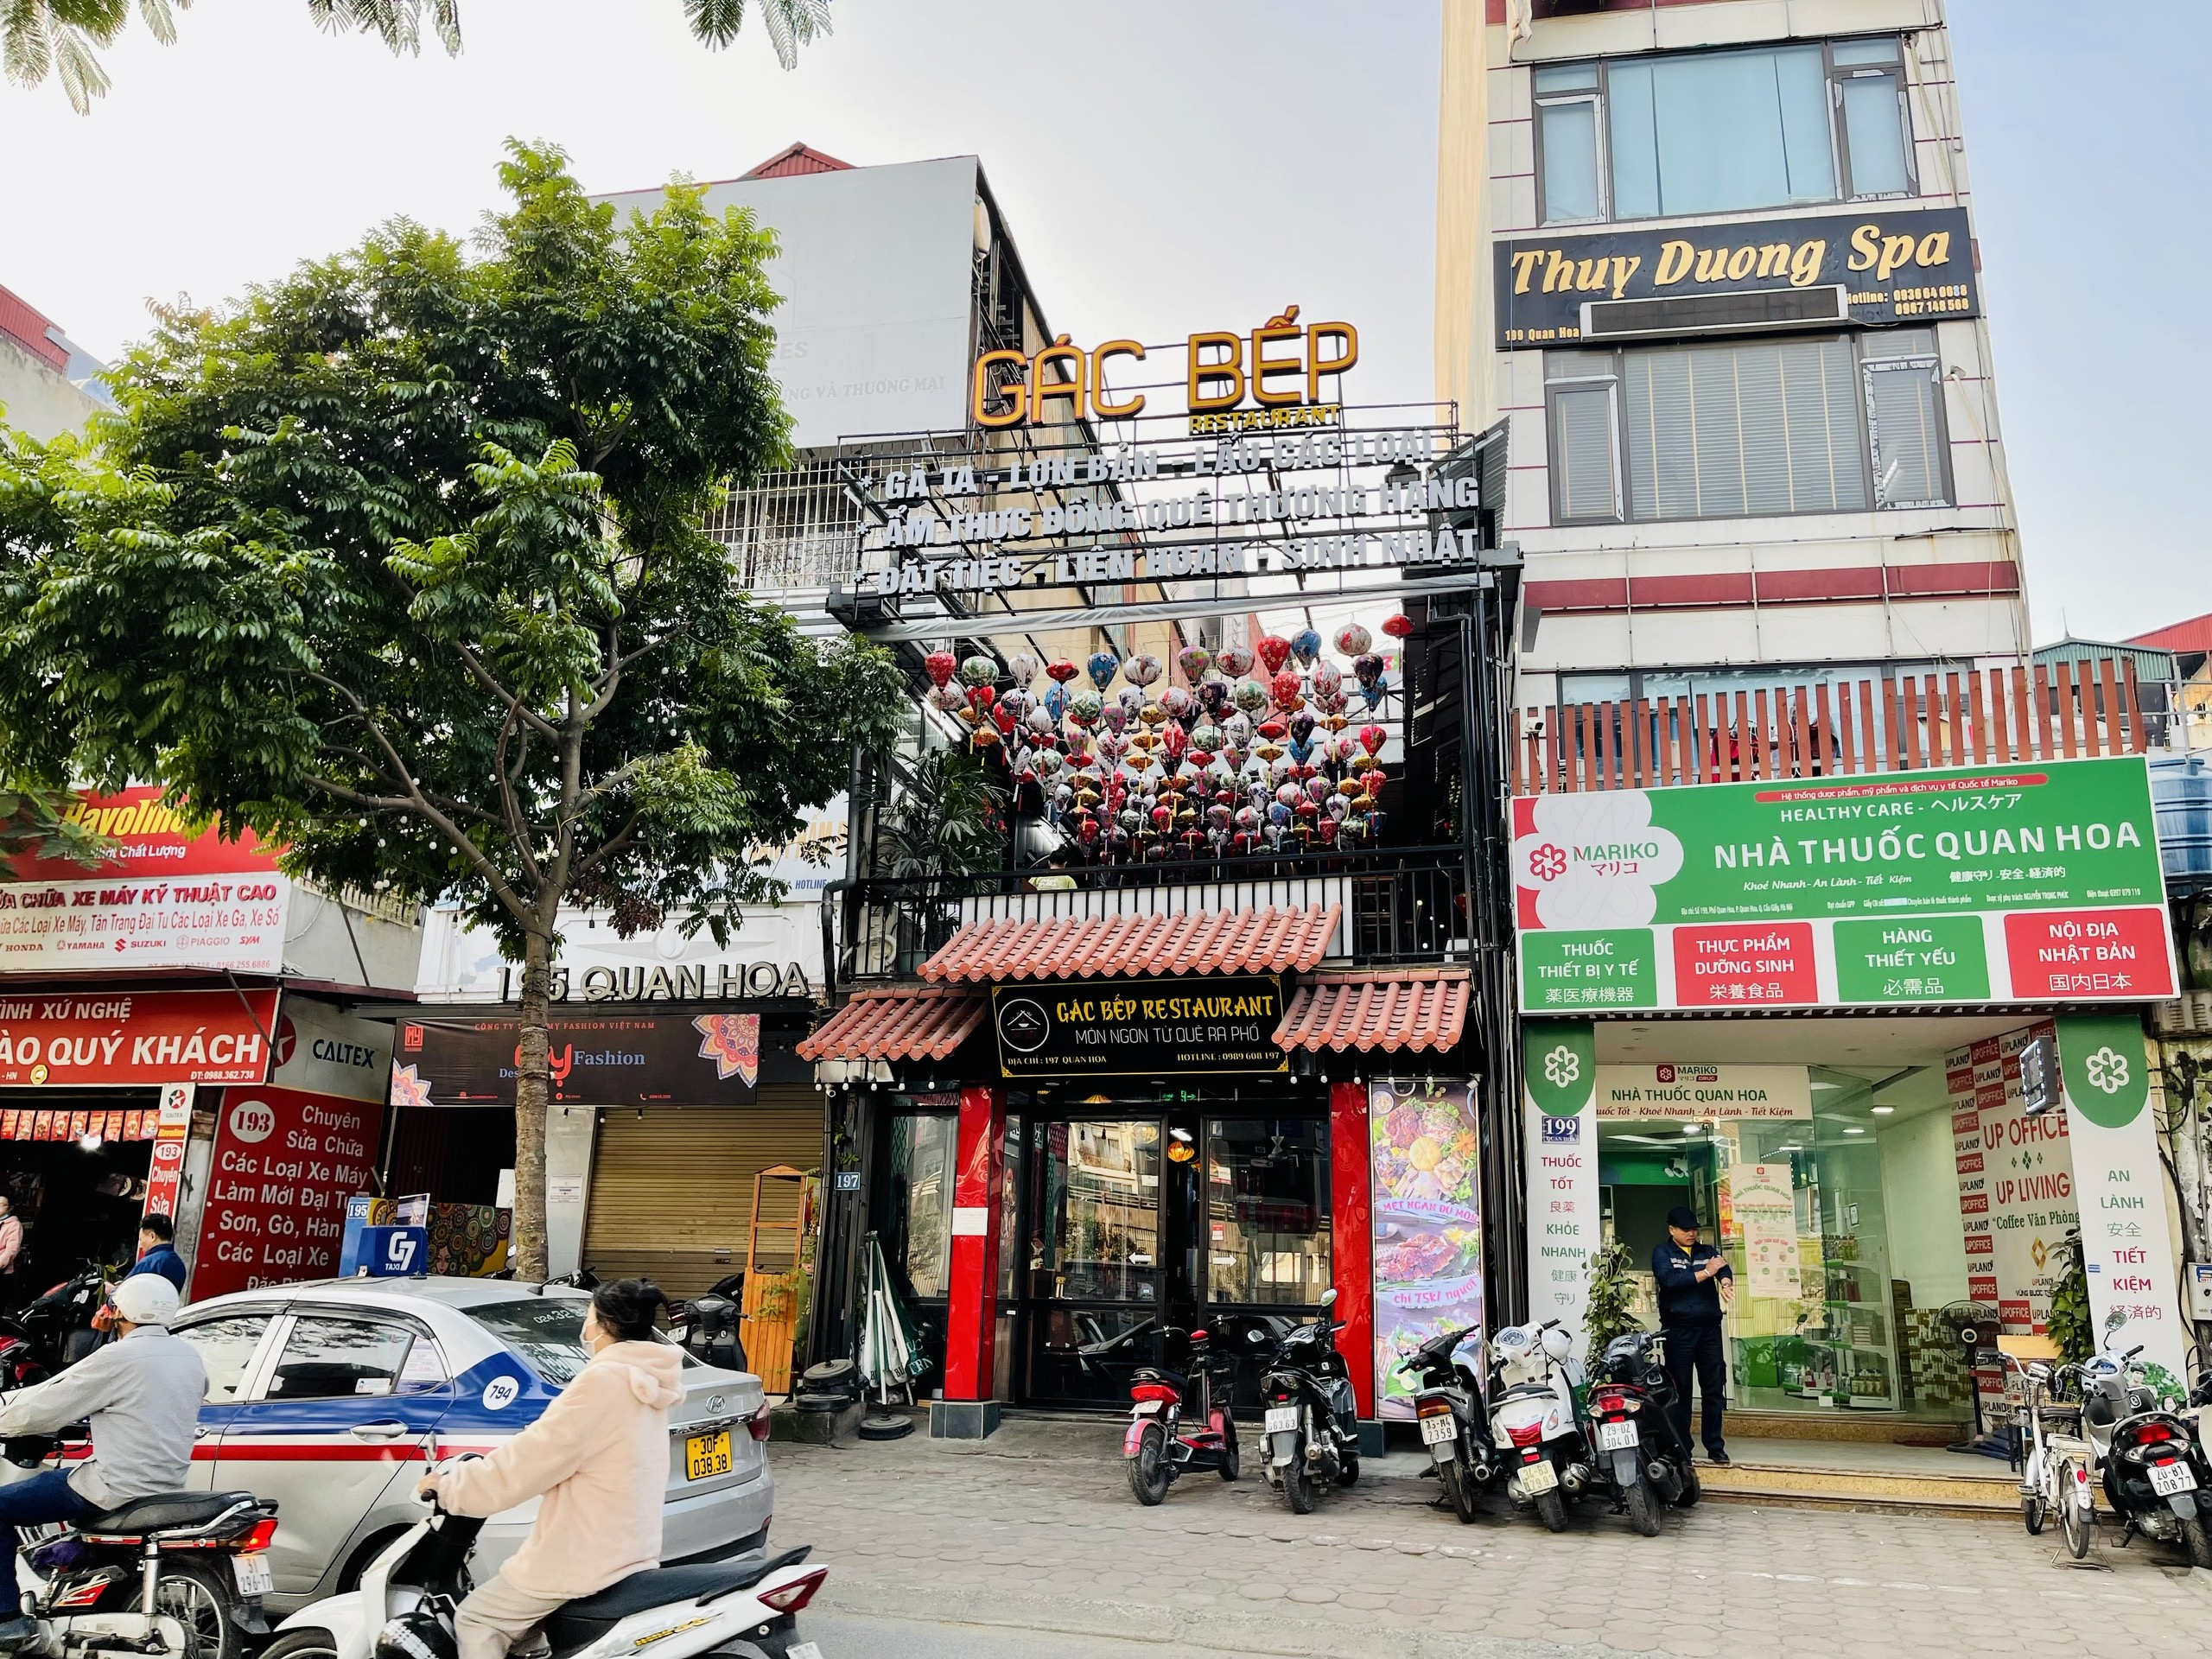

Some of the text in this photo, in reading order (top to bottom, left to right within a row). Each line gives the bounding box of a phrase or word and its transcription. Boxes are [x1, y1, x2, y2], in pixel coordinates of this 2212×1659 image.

[1512, 225, 1950, 299] Thuy Duong Spa
[1528, 327, 1580, 341] Quan Hoa
[972, 304, 1358, 426] GÁC BẾP
[1188, 405, 1340, 432] RESTAURANT
[886, 432, 1433, 499] GÀ TA LỢN BẢN CÁC LOẠI
[950, 478, 1478, 545] THỰC QUÊ THƯỢNG HẠNG
[1058, 523, 1477, 582] LIÊN HOAN SINH NHẬT
[1931, 793, 2022, 811] ヘルスケア
[1781, 802, 1914, 822] HEALTHY CARE
[149, 845, 186, 859] Lượng
[1573, 842, 1659, 861] MARIKO
[1714, 822, 2141, 868] NHÀ THUỐC QUAN HOA
[1591, 861, 1637, 877] マリコ
[1772, 874, 1912, 889] Nhanh An Lành Tiết Kiệm
[21, 882, 276, 909] CHỮA XE MÁY KỸ THUẬT CAO
[31, 908, 263, 938] Loại Xe Tân Trang Đại Tu Các Loại Xe Xe
[2049, 921, 2119, 940] NỘI ĐỊA
[5, 943, 43, 951] HONDA
[67, 940, 105, 950] YAMAHA
[191, 937, 230, 946] PIAGGIO
[239, 936, 259, 944] SYM
[1696, 932, 1790, 955] THỰC PHẨM
[1883, 927, 1933, 944] HÀNG
[1561, 938, 1613, 956] THUỐC
[2039, 942, 2136, 964] NHẬT BẢN
[1865, 947, 1956, 967] THIẾT YẾU
[1538, 959, 1638, 980] THIẾT BỊ Y TẾ
[1695, 958, 1794, 975] DƯỠNG SINH
[581, 961, 811, 1001] QUAN HOA
[1884, 977, 1944, 996] 必需品
[2050, 973, 2132, 991] 国内日本
[1710, 982, 1783, 1000] 栄養食品
[41, 998, 132, 1022] XỨ NGHỆ
[1057, 994, 1273, 1023] GÁC BẾP RESTAURANT
[609, 1020, 632, 1032] VIỆT
[1110, 1022, 1259, 1044] NGON QUÊ RA PHỐ
[48, 1027, 261, 1065] QUÝ KHÁCH
[312, 1039, 375, 1070] CALTEX
[574, 1050, 645, 1065] Fashion
[1677, 1066, 1718, 1075] MARIKO
[1611, 1085, 1767, 1102] NHÀ THUỐC QUAN HOA
[236, 1104, 360, 1132] 193 Chuyên
[1618, 1106, 1793, 1116] Tốt Nhanh An Lành Tiết Kiệm
[1546, 1119, 1576, 1135] 199
[286, 1128, 364, 1157] Sửa Chữa
[1983, 1123, 2004, 1150] UP
[161, 1147, 178, 1157] 193
[1541, 1154, 1581, 1167] THUỐC
[221, 1150, 368, 1189] Các Loại Xe Máy
[1958, 1159, 1982, 1170] UPOFFICE
[836, 1173, 859, 1189] 197
[1550, 1176, 1573, 1189] TỐT
[1960, 1179, 1983, 1190] UPLAND
[2108, 1170, 2130, 1182] AN
[214, 1179, 330, 1211] Làm Mới Đại
[1996, 1173, 2070, 1204] UP LIVING
[348, 1203, 368, 1217] 195
[2101, 1193, 2144, 1209] LÀNH
[219, 1210, 340, 1237] Sơn, Gò, Hàn
[1547, 1221, 1580, 1235] KHỎE
[2028, 1211, 2046, 1227] Văn
[2107, 1223, 2141, 1237] 安全
[218, 1240, 329, 1268] Các Loại Xe
[389, 1231, 416, 1270] G7
[1541, 1247, 1586, 1258] NHANH
[2113, 1246, 2146, 1263] TIẾT
[1552, 1269, 1577, 1282] 健康
[2113, 1278, 2152, 1294] KIỆM
[2001, 1306, 2030, 1318] UPOFFICE
[488, 1385, 510, 1400] 794
[701, 1437, 717, 1455] 30F
[694, 1458, 727, 1478] 038.38
